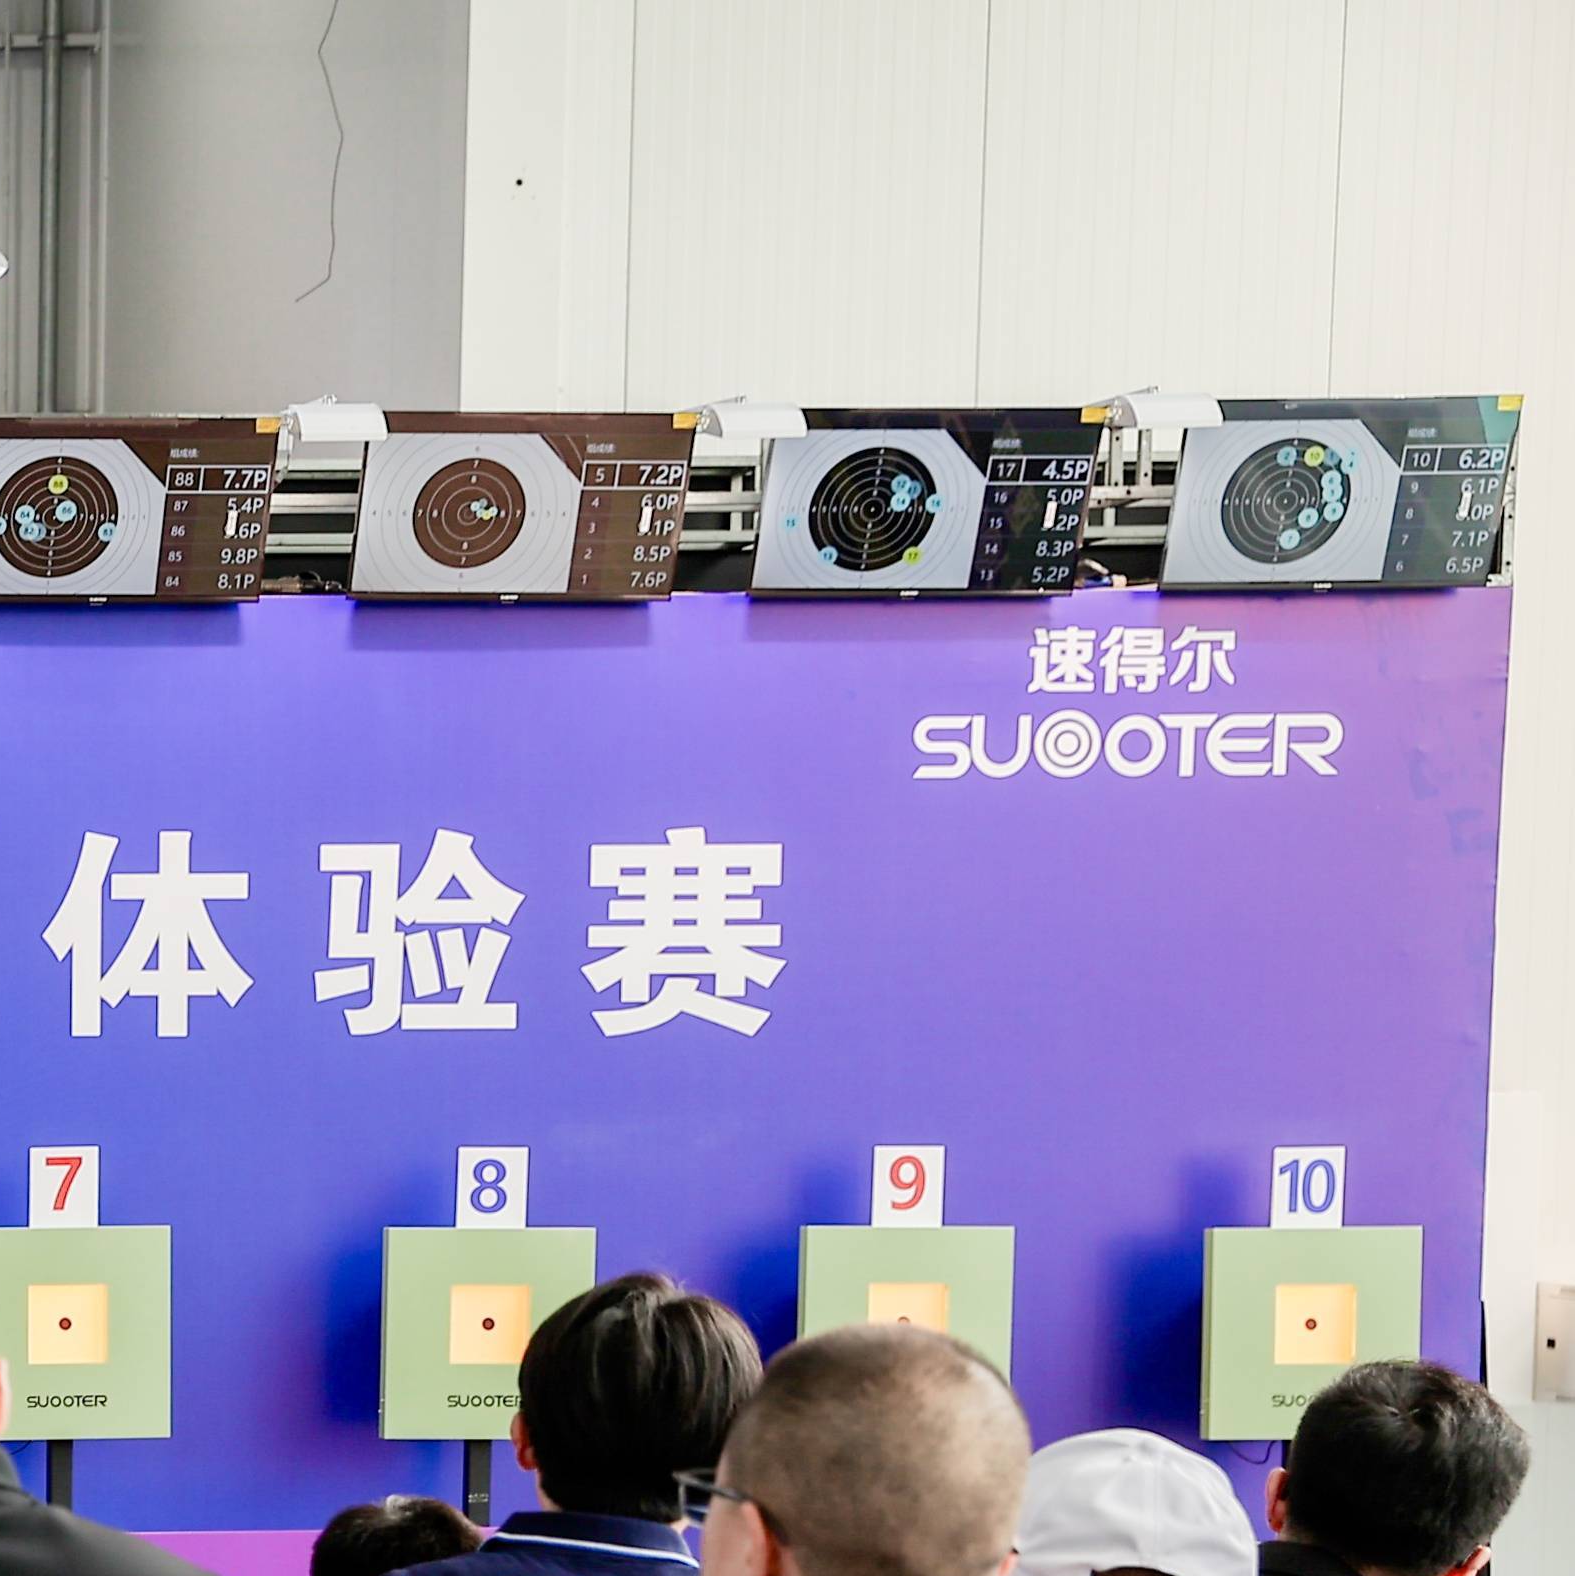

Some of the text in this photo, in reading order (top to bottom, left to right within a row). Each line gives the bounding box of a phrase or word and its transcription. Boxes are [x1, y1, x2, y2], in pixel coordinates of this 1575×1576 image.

[1412, 449, 1505, 469] 10 6.2P
[595, 466, 682, 485] 5 7.2P
[998, 461, 1088, 480] 17 4.5P
[175, 470, 267, 489] 88 7.7P
[1411, 478, 1499, 494] 9 6.1P
[174, 498, 264, 514] 87 5.4P
[591, 494, 679, 511] 4 6.0P
[1046, 489, 1084, 506] 5.0P
[1406, 508, 1413, 519] 8
[588, 520, 675, 536] 3 .1P
[1041, 514, 1079, 531] .2P
[171, 524, 261, 539] 86 .6P
[1451, 531, 1488, 548] 7.1P
[168, 549, 258, 565] 85 9.8P
[584, 546, 671, 562] 2 8.5P
[1035, 541, 1074, 558] 8.3P
[1445, 558, 1483, 573] 6.5P
[165, 574, 255, 590] 84 8.1P
[582, 572, 667, 588] 1 7.6P
[1031, 567, 1069, 583] 5.2P
[1027, 626, 1237, 693] 速得尔
[912, 709, 1345, 779] SUOOTER
[45, 1156, 83, 1212] 7
[471, 1158, 508, 1214] 8
[888, 1154, 926, 1212] 9
[1279, 1158, 1336, 1215] 10
[26, 1395, 107, 1409] SUOOTER
